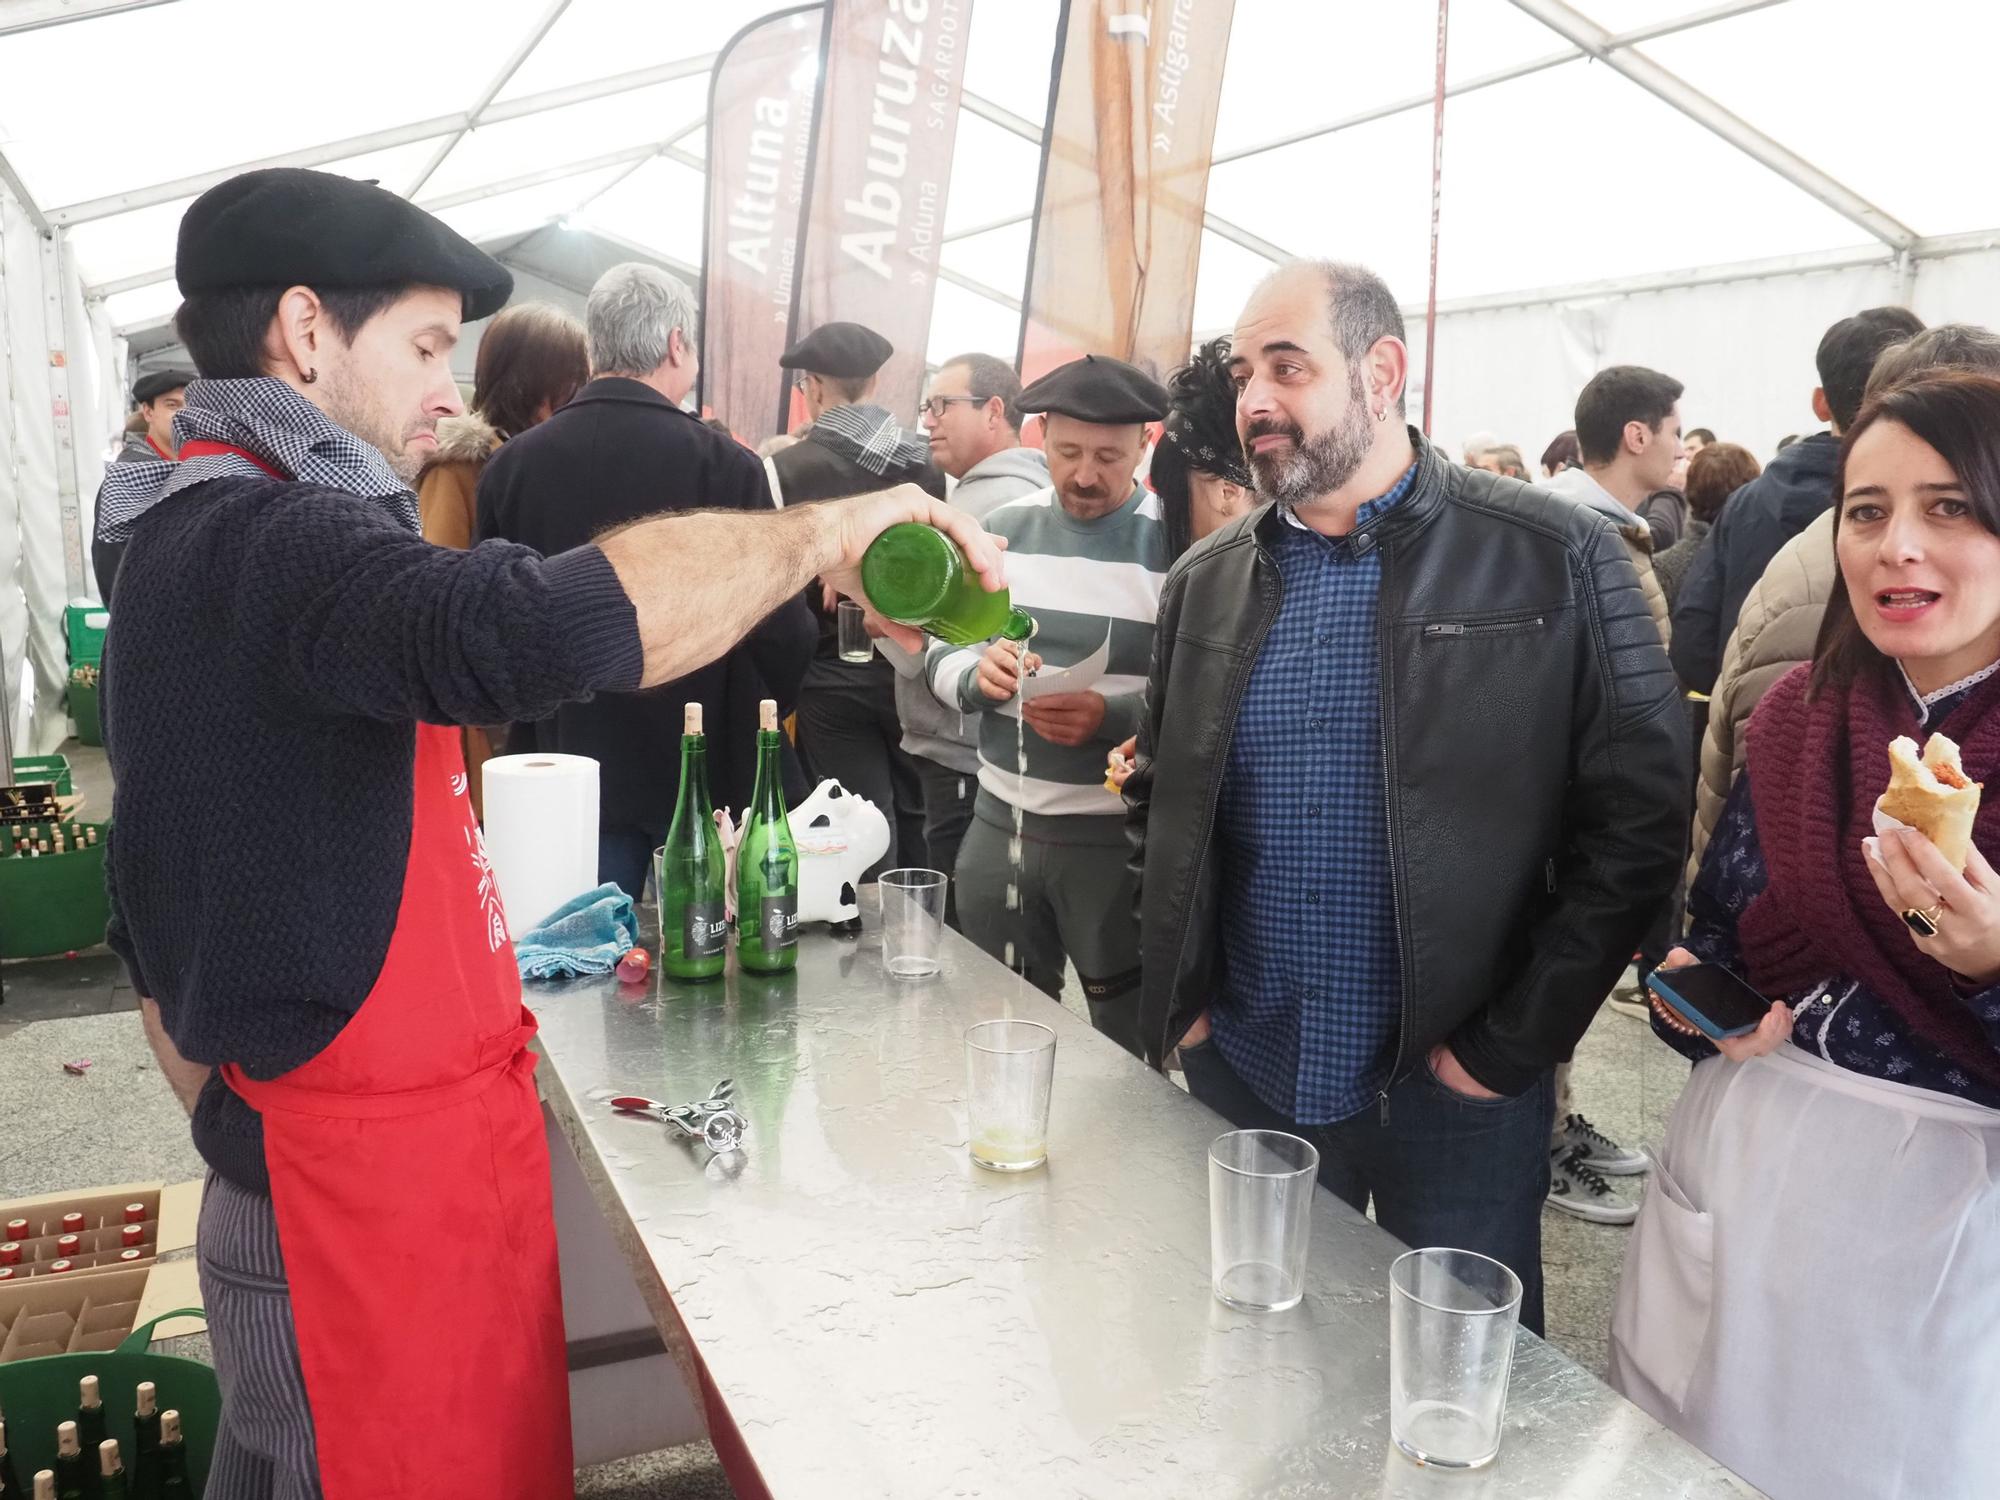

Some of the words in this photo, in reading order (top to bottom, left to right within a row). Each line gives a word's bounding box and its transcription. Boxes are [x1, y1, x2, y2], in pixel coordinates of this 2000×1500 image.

[727, 96, 790, 275] Altuna
[840, 0, 928, 280] Aburuza
[775, 238, 797, 307] Umieta
[908, 181, 938, 262] Aduna
